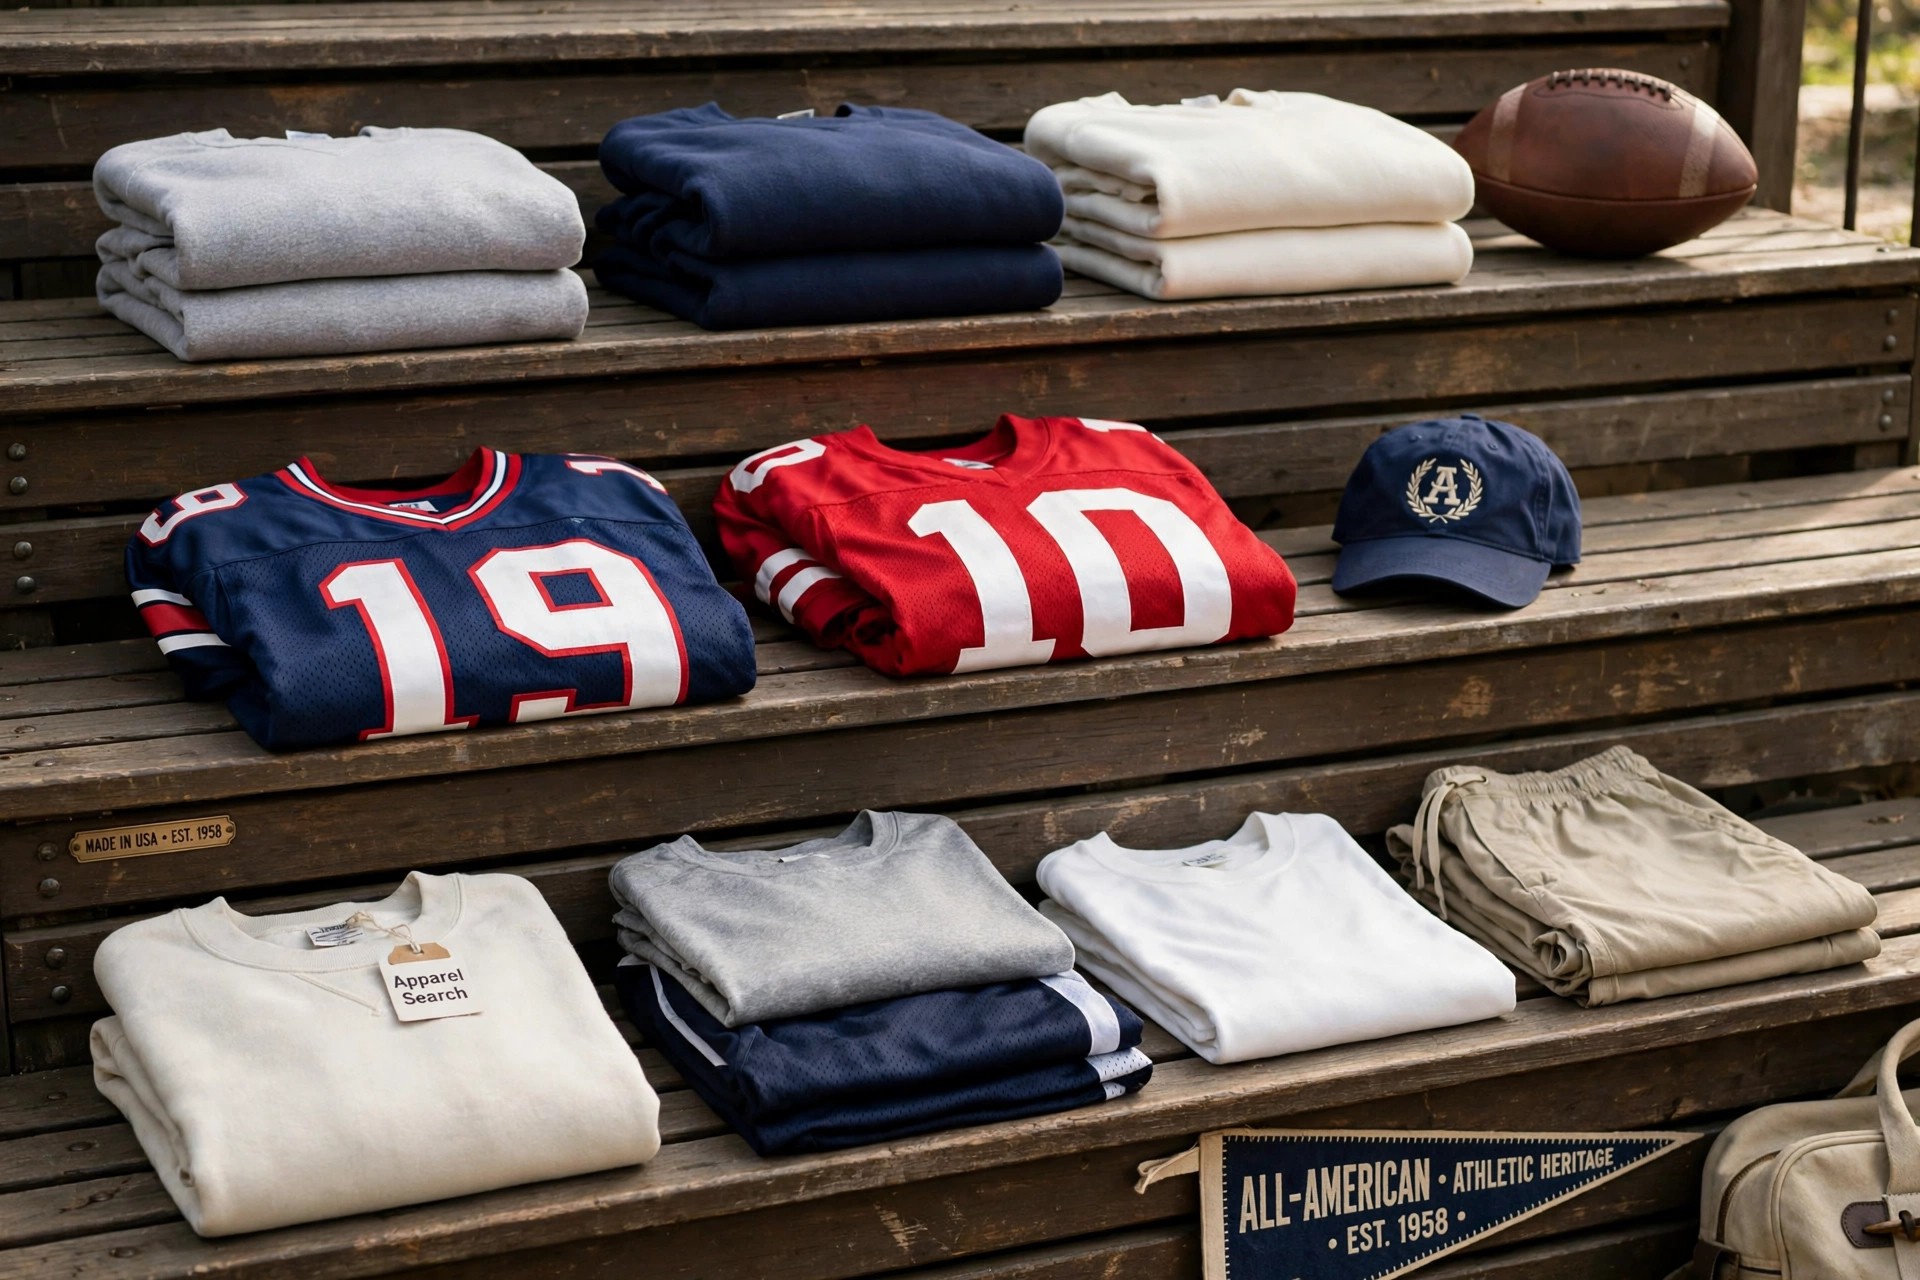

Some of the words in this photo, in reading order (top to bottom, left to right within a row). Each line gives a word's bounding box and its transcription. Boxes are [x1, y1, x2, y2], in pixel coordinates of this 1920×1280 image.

[1423, 466, 1461, 506] A
[907, 487, 1233, 674] 10
[318, 538, 691, 741] 19
[85, 834, 117, 853] MADE
[120, 834, 132, 849] IN
[135, 832, 158, 848] USA
[171, 828, 194, 844] EST.
[197, 824, 222, 840] 1958
[394, 968, 464, 990] Apparel
[402, 987, 468, 1005] Search
[1239, 1157, 1430, 1234] ALL-AMERICAN
[1452, 1155, 1534, 1194] ATHLETIC
[1540, 1147, 1614, 1180] HERITAGE
[1347, 1219, 1390, 1255] EST.
[1398, 1207, 1449, 1243] 1958
